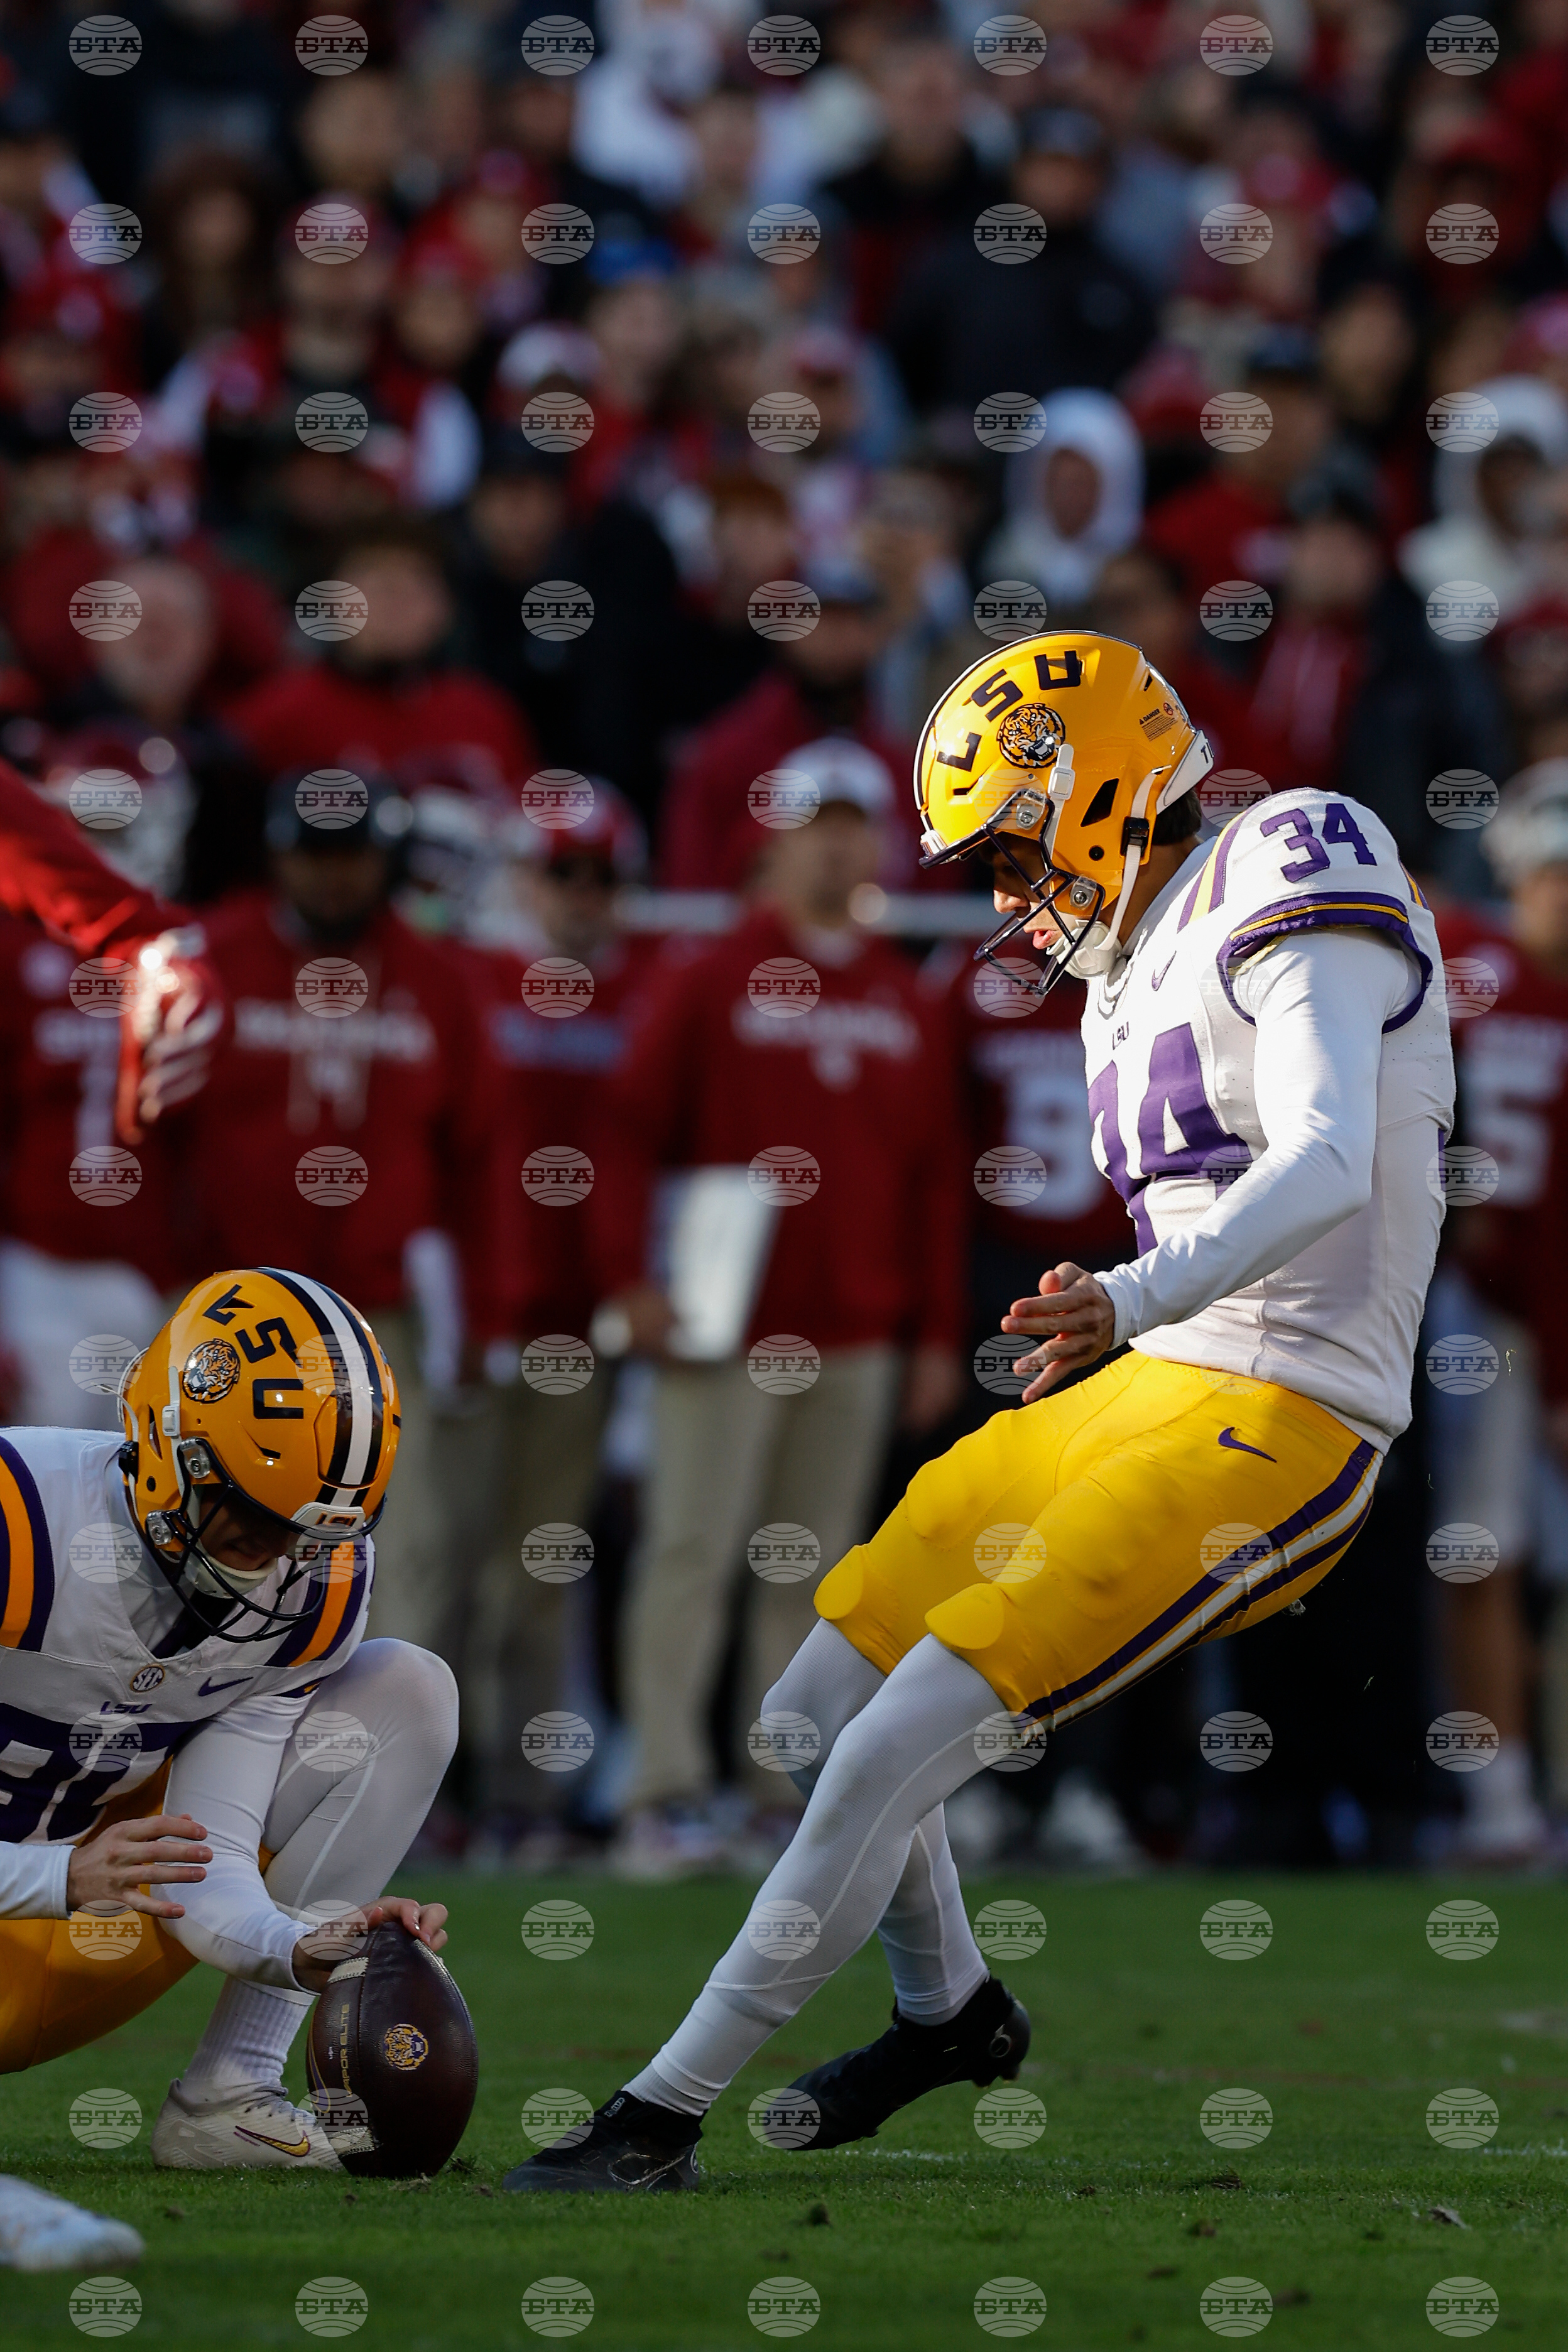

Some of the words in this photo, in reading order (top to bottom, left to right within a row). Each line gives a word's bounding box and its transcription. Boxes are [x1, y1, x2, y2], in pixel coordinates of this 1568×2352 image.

[937, 650, 1081, 772] LSU
[1260, 803, 1378, 883] 34
[1112, 1021, 1130, 1051] LSU
[202, 1283, 304, 1420] LSU
[133, 1667, 163, 1691] SEC
[99, 1701, 153, 1716] LSU
[340, 2004, 349, 2045] ELITE
[340, 2049, 352, 2097] VAPOR
